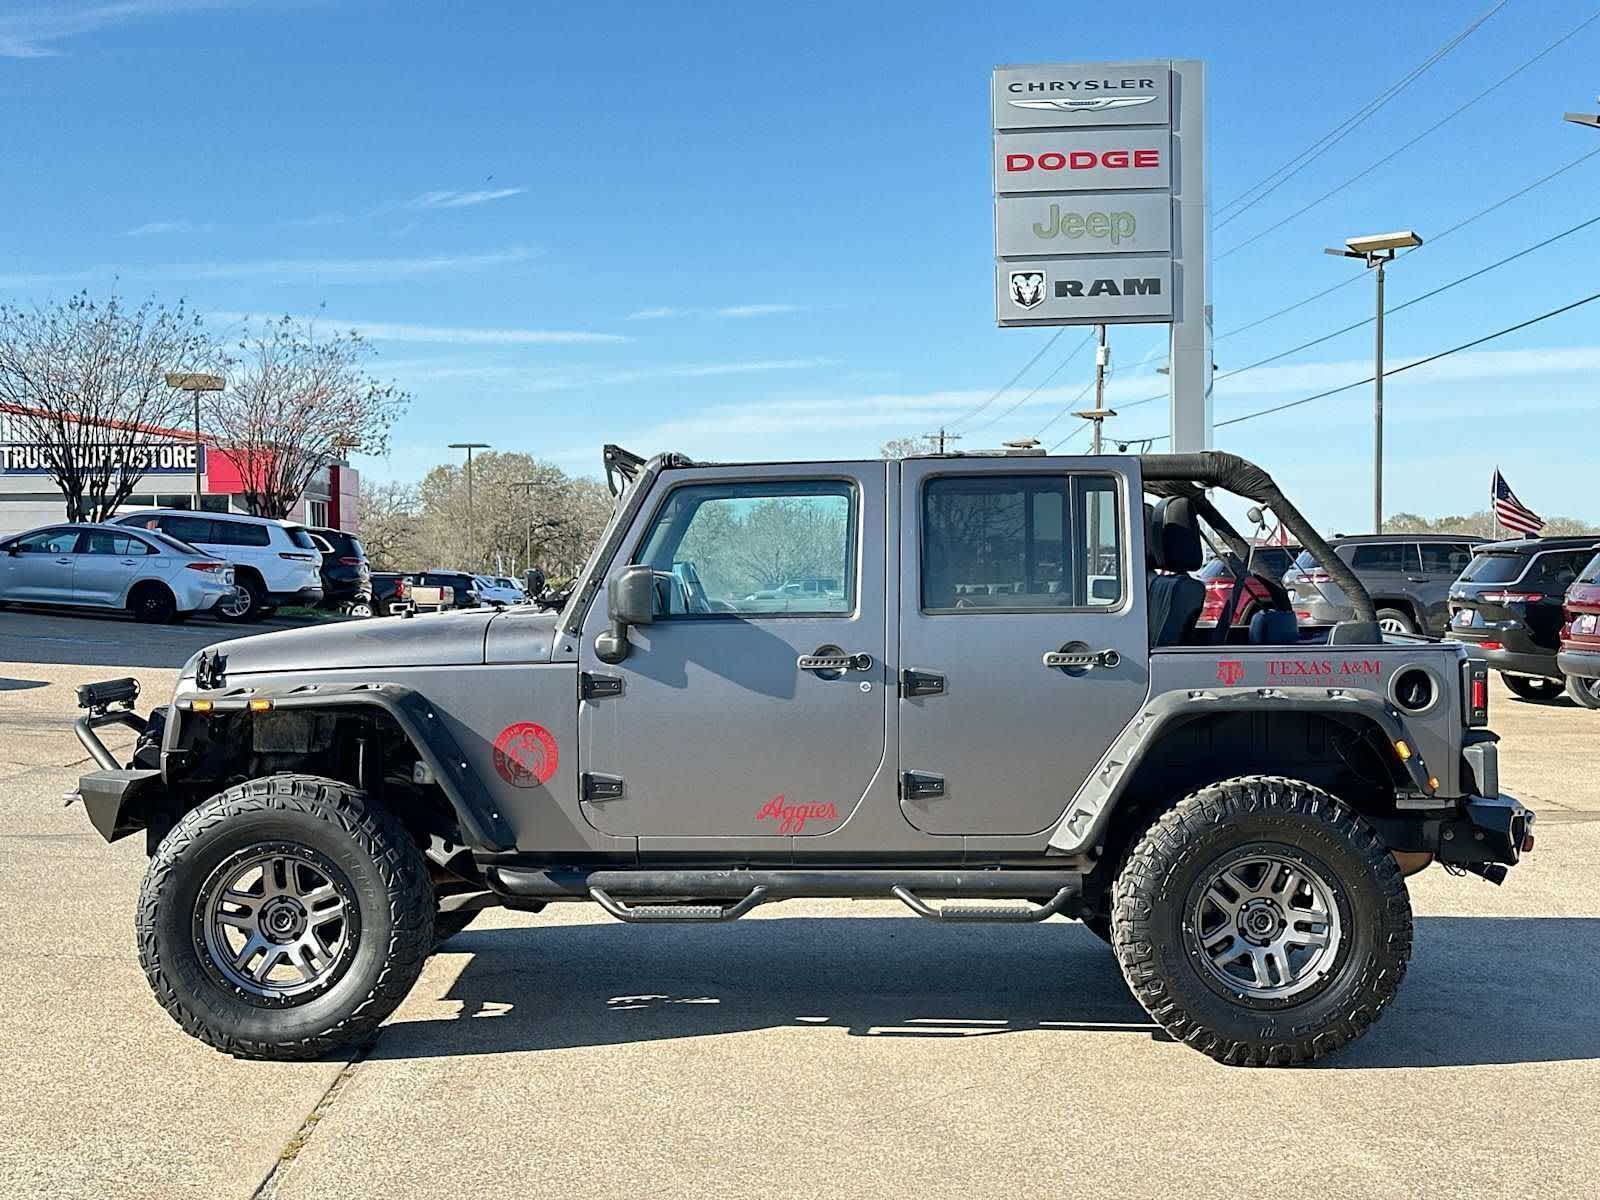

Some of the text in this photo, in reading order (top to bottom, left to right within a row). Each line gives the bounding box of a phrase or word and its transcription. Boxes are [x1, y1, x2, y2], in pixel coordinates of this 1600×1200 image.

[1007, 79, 1155, 93] CHRYSLER
[1006, 150, 1160, 172] DODGE
[1032, 204, 1136, 245] Jeep
[1054, 278, 1161, 297] RAM
[1265, 661, 1381, 675] TEXAS A&M
[756, 793, 837, 834] Aggies
